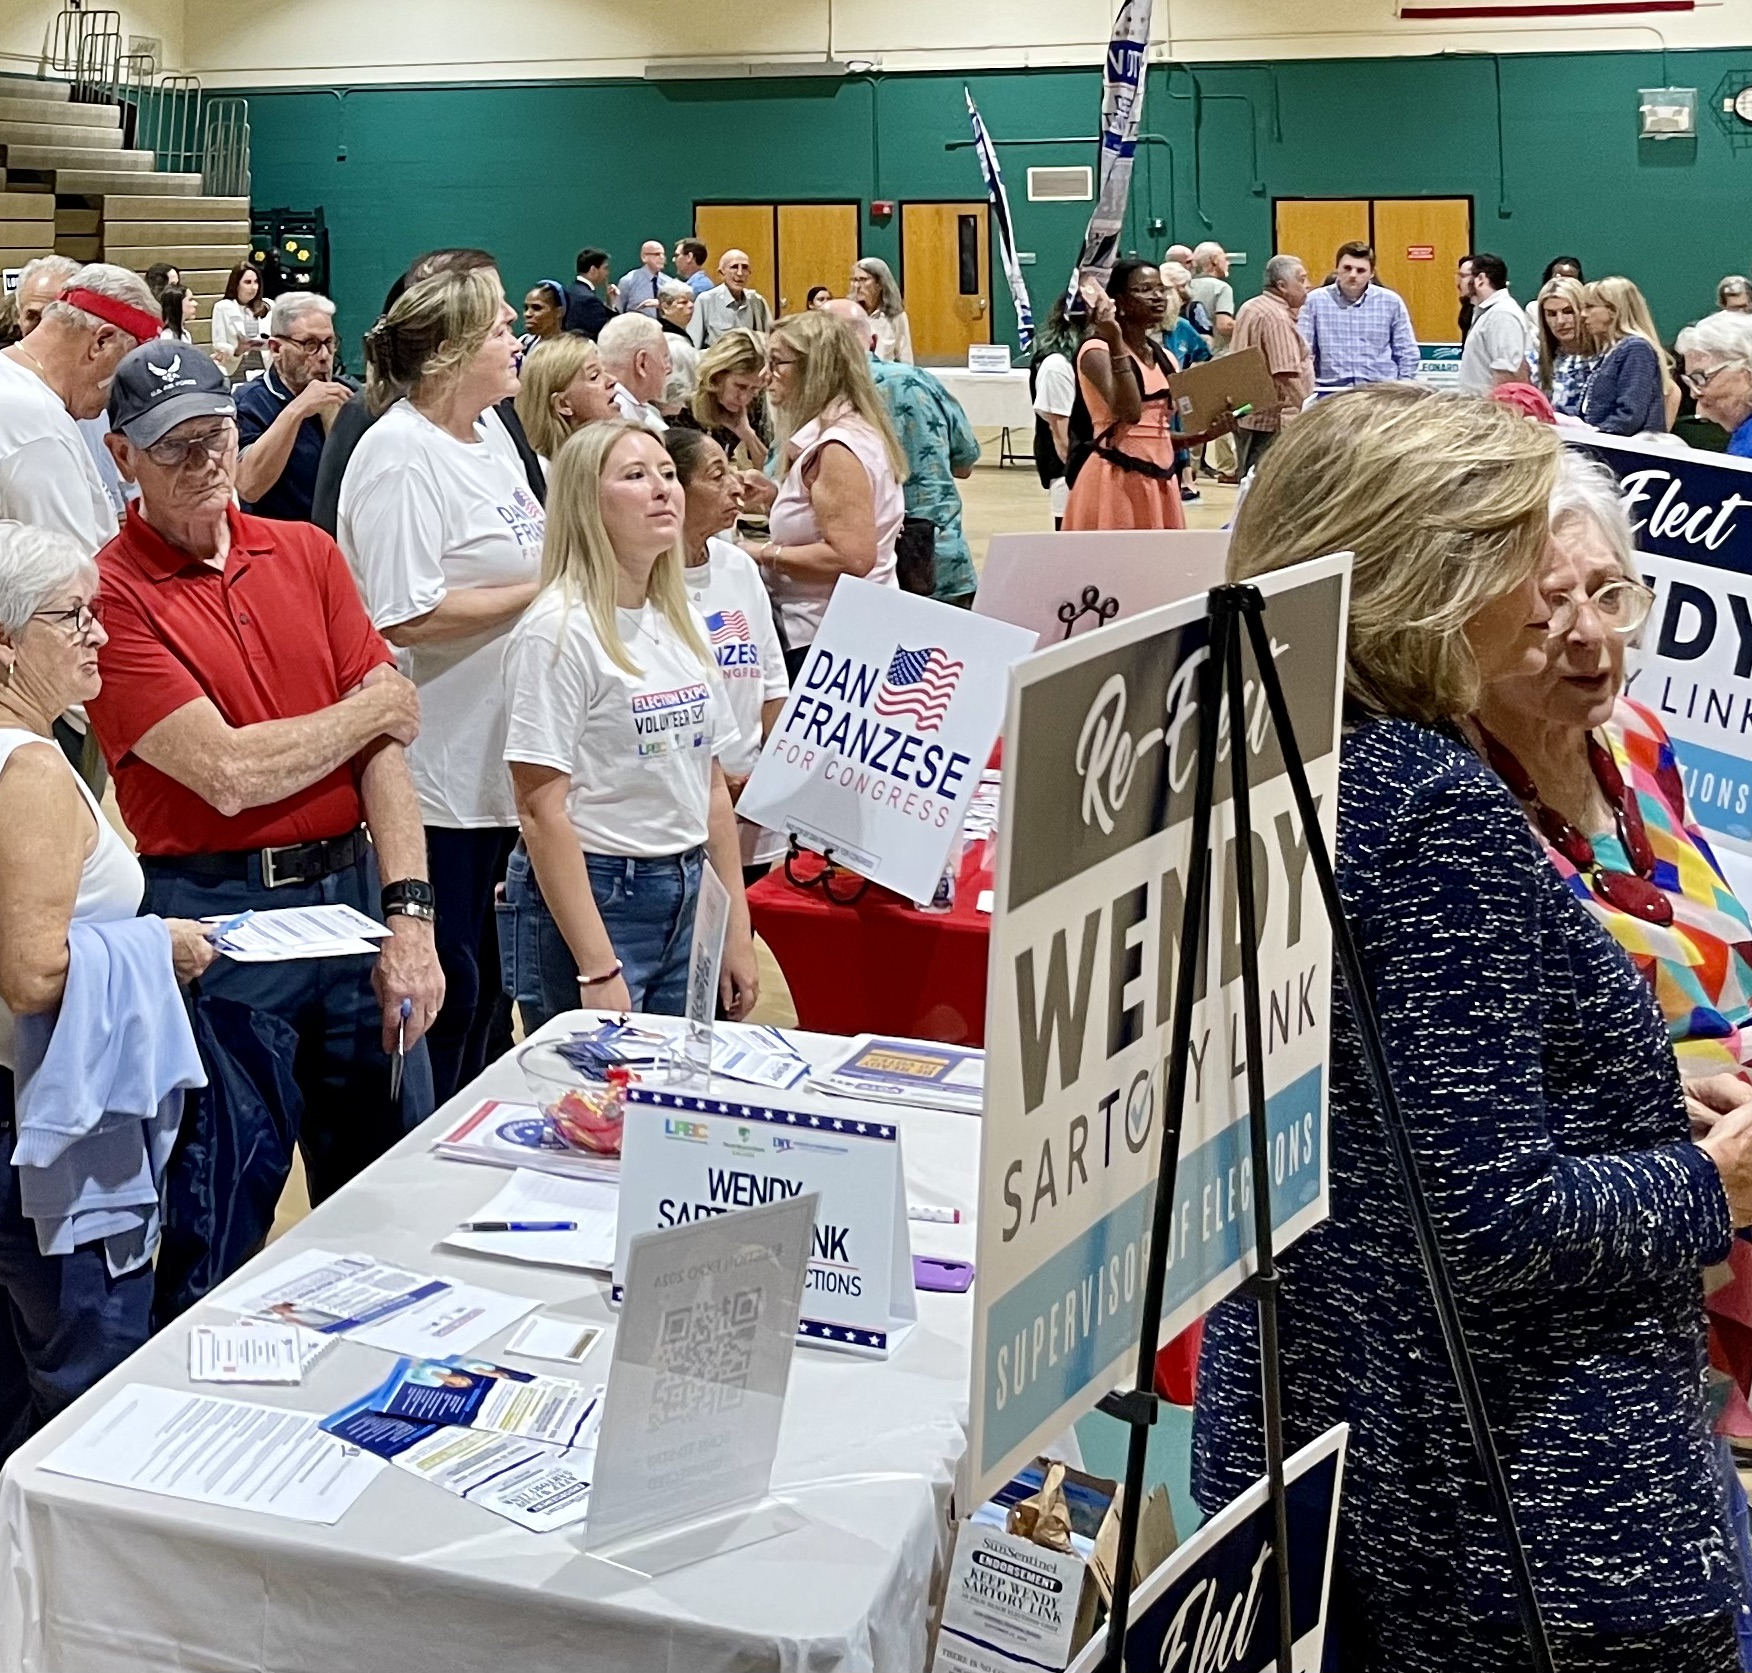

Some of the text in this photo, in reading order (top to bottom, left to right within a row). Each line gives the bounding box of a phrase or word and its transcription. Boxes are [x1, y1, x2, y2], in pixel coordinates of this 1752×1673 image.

[1620, 469, 1752, 551] Elect
[633, 684, 708, 712] ELECTION EXPO
[805, 649, 880, 708] DAN
[785, 695, 971, 800] FRANZESE
[772, 739, 950, 829] FOR CONGRESS
[1015, 793, 1325, 1116] WENDY
[1002, 963, 1317, 1243] SARTOY LNK
[708, 1167, 803, 1206] WENDY
[813, 1223, 850, 1263] NK
[996, 1230, 1152, 1411] SUPERVISOR
[1201, 1112, 1313, 1243] ELECIONS
[803, 1269, 862, 1298] CTIONS
[978, 1553, 1057, 1591] ENDORSEMENT
[982, 1537, 1058, 1575] SunSentinel
[962, 1577, 1063, 1624] SARTORY LINK
[970, 1567, 1061, 1610] KEEP WENDY
